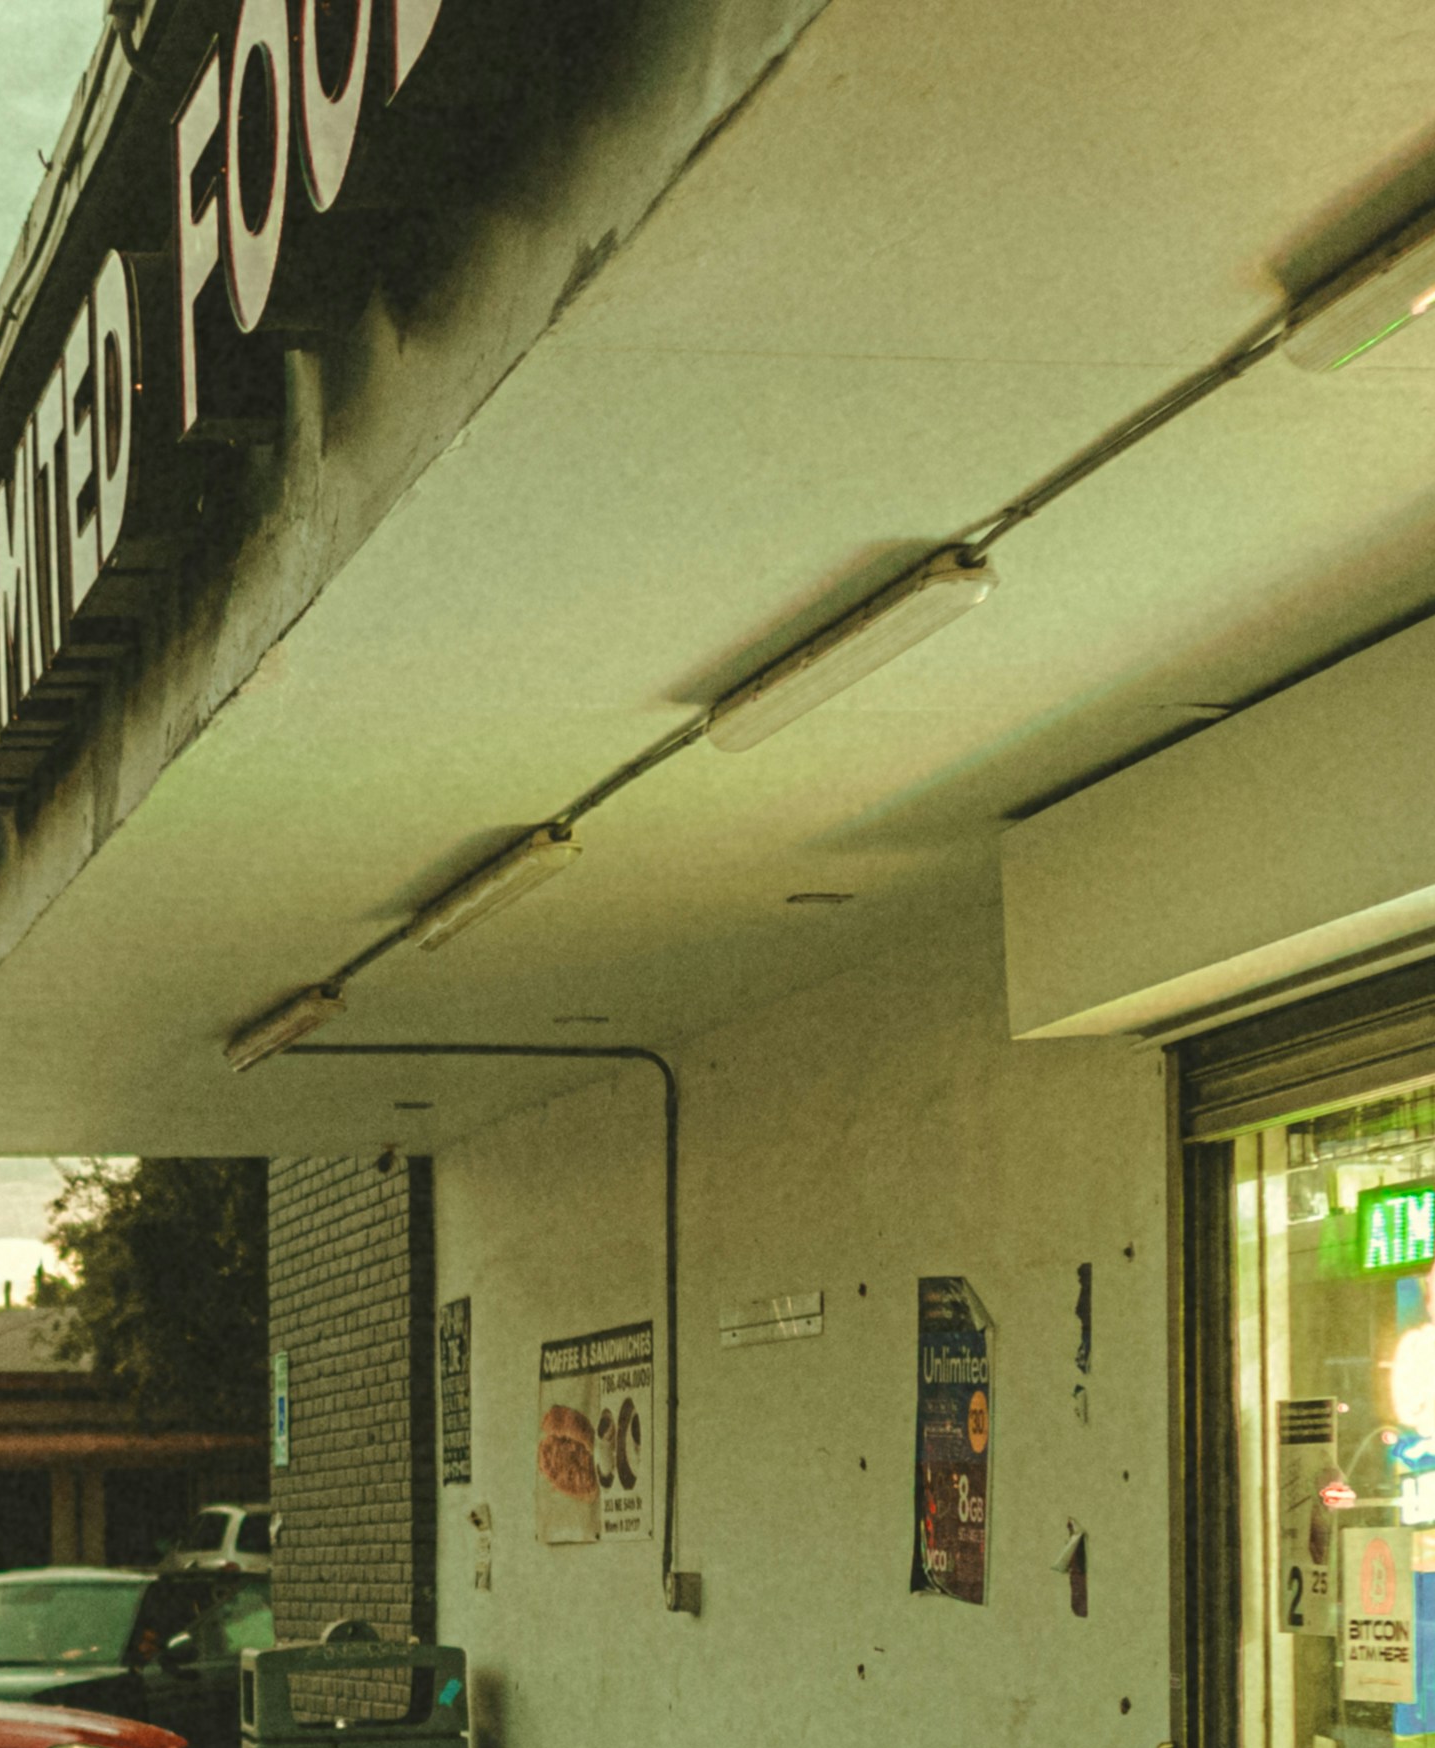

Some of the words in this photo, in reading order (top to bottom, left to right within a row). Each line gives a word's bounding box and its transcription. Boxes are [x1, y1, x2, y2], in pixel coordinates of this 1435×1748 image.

[171, 0, 443, 443] FOO
[1364, 1192, 1435, 1269] ATM
[544, 1346, 579, 1374] COFFEE
[590, 1330, 651, 1366] SANDWICHES
[923, 1346, 988, 1384] Unlimited
[958, 1474, 969, 1523] 8
[1287, 1565, 1305, 1627] 2
[1311, 1571, 1329, 1595] 25
[1348, 1619, 1410, 1641] BITCOIN
[1349, 1645, 1378, 1662] ATM
[1379, 1646, 1410, 1663] HERE
